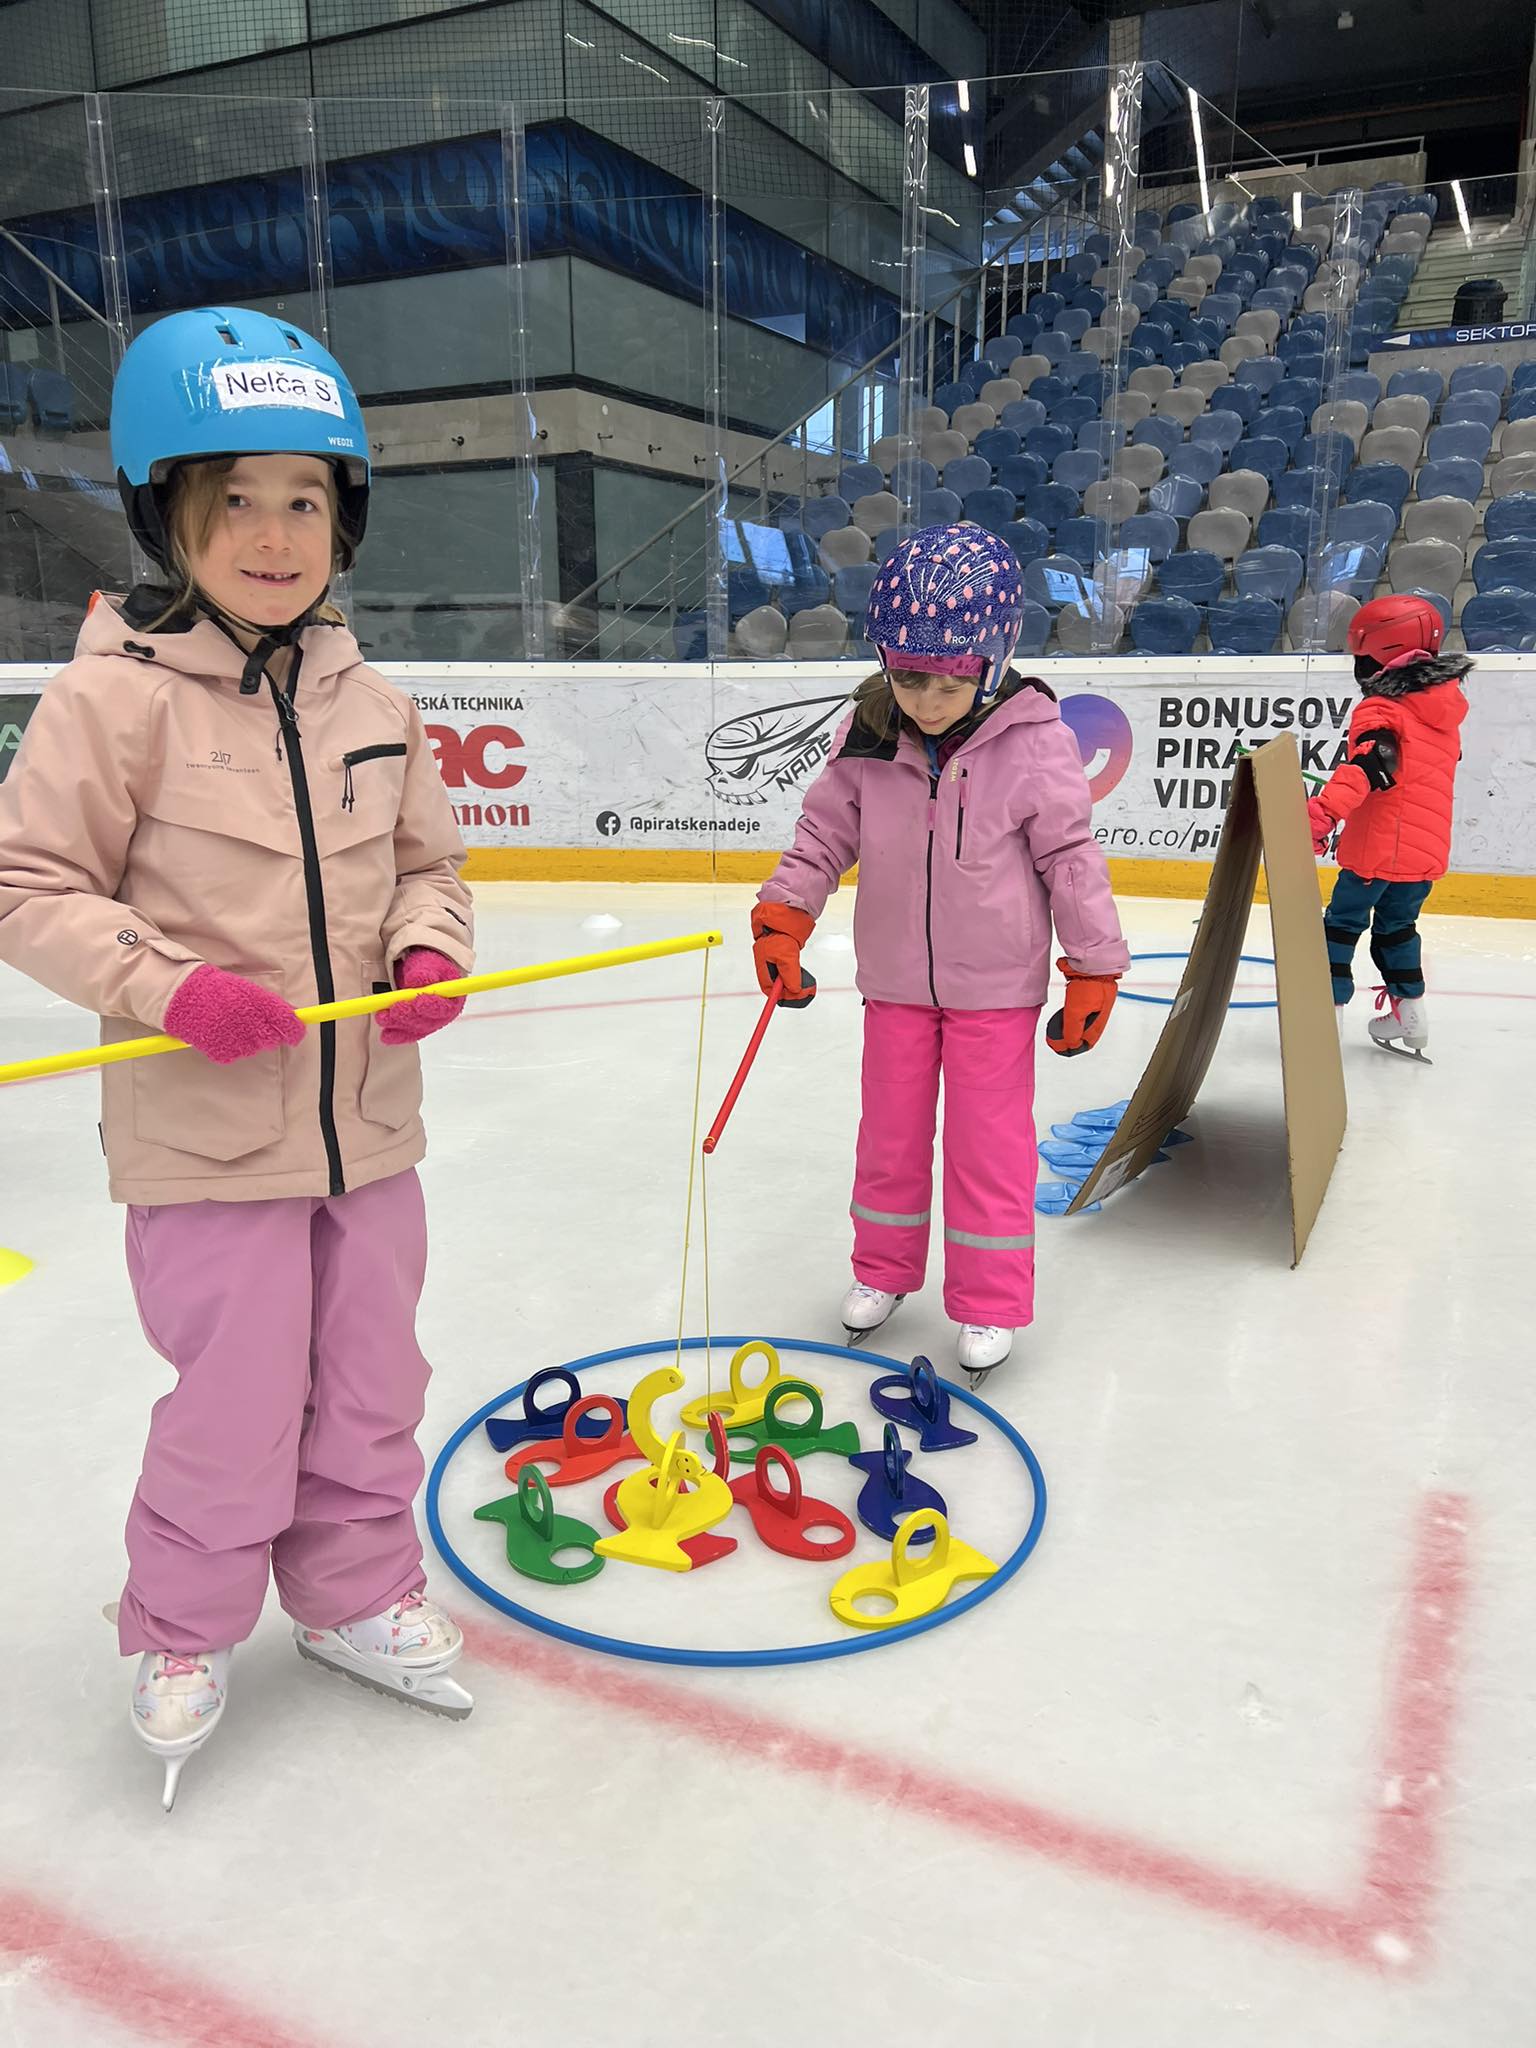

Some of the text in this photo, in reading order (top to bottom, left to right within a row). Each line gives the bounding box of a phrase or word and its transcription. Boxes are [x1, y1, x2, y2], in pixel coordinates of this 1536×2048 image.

[225, 371, 338, 406] Nelča S.
[452, 697, 524, 711] TECHNIKA
[1159, 697, 1353, 728] BONUSOV
[1156, 729, 1350, 770] PIRÁKÁ
[451, 804, 530, 826] non
[630, 816, 761, 834] @piratskenadeje
